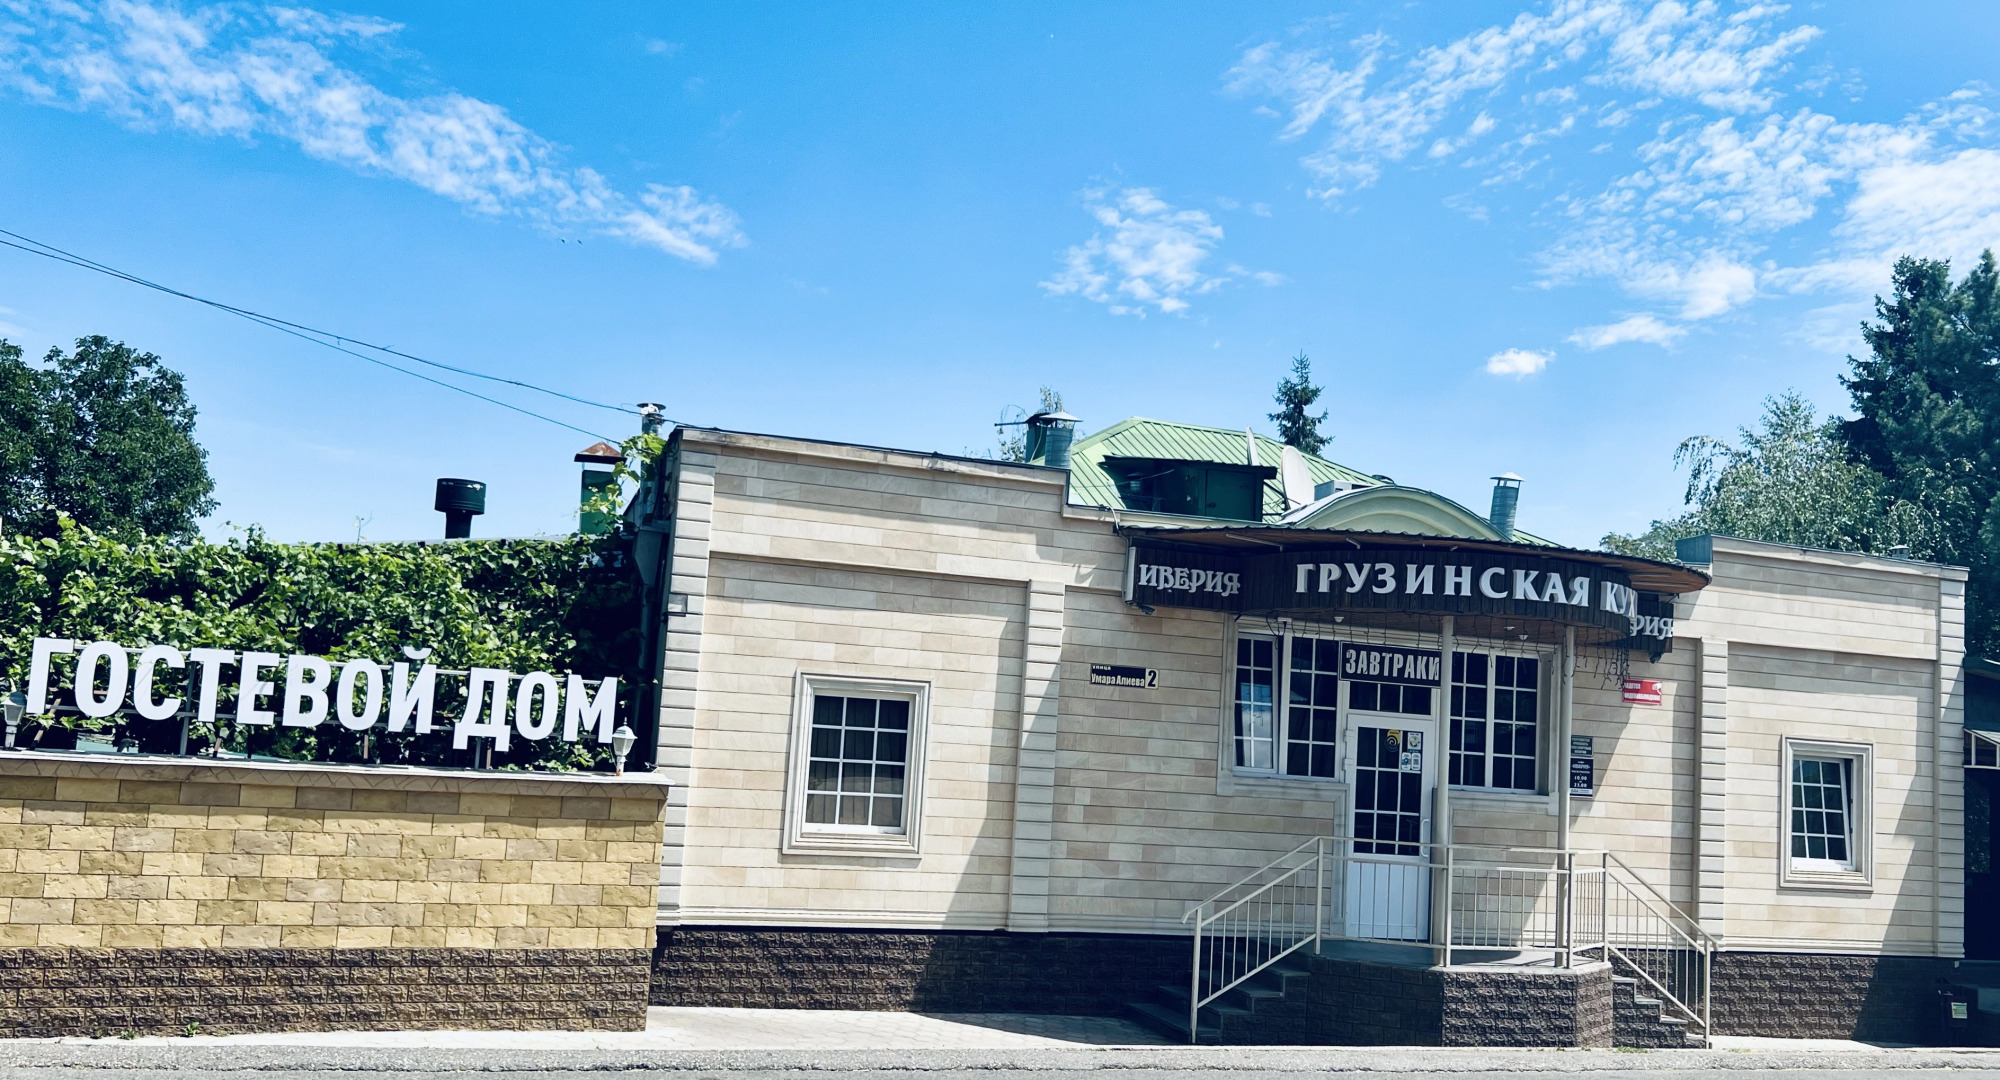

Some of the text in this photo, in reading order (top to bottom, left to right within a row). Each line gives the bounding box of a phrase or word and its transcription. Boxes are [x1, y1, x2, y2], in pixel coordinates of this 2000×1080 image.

[1138, 563, 1241, 597] ИВЕРИЯ
[1296, 561, 1590, 607] ГРУЗИНСКАЯ
[1629, 613, 1674, 640] РИЯ
[1091, 670, 1157, 687] Умара Алиева 2
[1345, 649, 1440, 681] ЗАВТРАКИ
[25, 637, 618, 752] ГОСТЕВОЙ ДОМ
